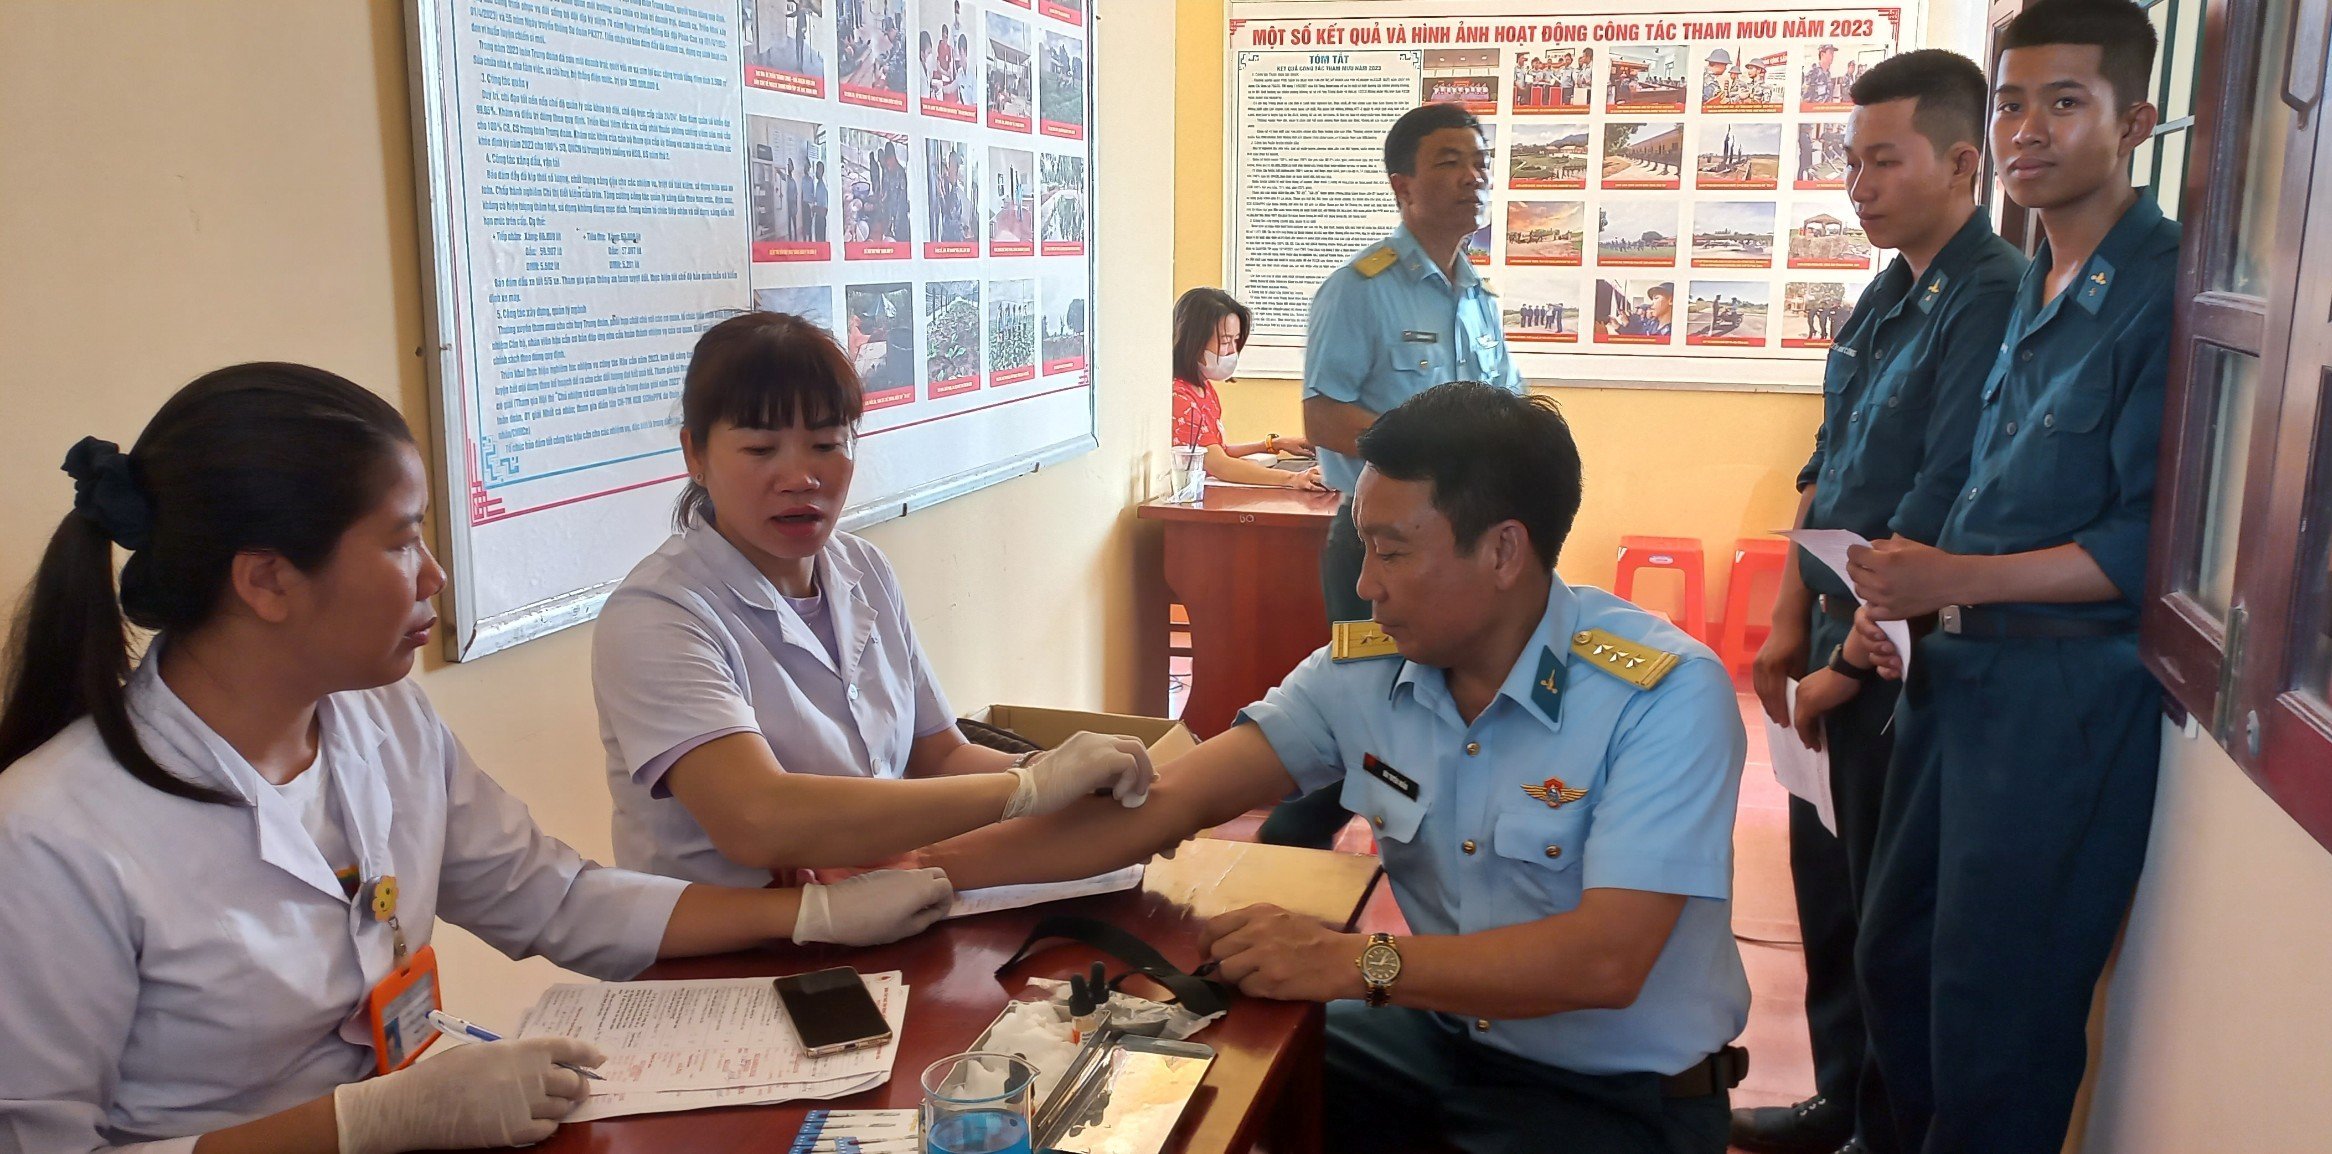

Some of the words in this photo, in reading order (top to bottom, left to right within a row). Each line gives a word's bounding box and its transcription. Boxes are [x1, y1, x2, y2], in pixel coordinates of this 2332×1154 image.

[1252, 26, 1286, 49] MỘT
[1290, 23, 1312, 45] SỐ
[1316, 23, 1345, 45] KẾT
[1349, 22, 1382, 46] QUẢ
[1386, 20, 1407, 44] VÀ
[1411, 23, 1450, 43] HÌNH
[1455, 21, 1489, 43] ẢNH
[1494, 25, 1537, 46] HOẠT
[1541, 22, 1588, 45] ĐỘNG
[1593, 21, 1639, 41] CÔNG
[1645, 20, 1677, 41] TÁC
[1683, 22, 1731, 40] THAM
[1737, 20, 1777, 39] MƯU
[1783, 16, 1825, 38] NĂM
[1830, 19, 1874, 37] 2023
[1309, 53, 1329, 64] TÓM
[1333, 51, 1350, 64] TẮT
